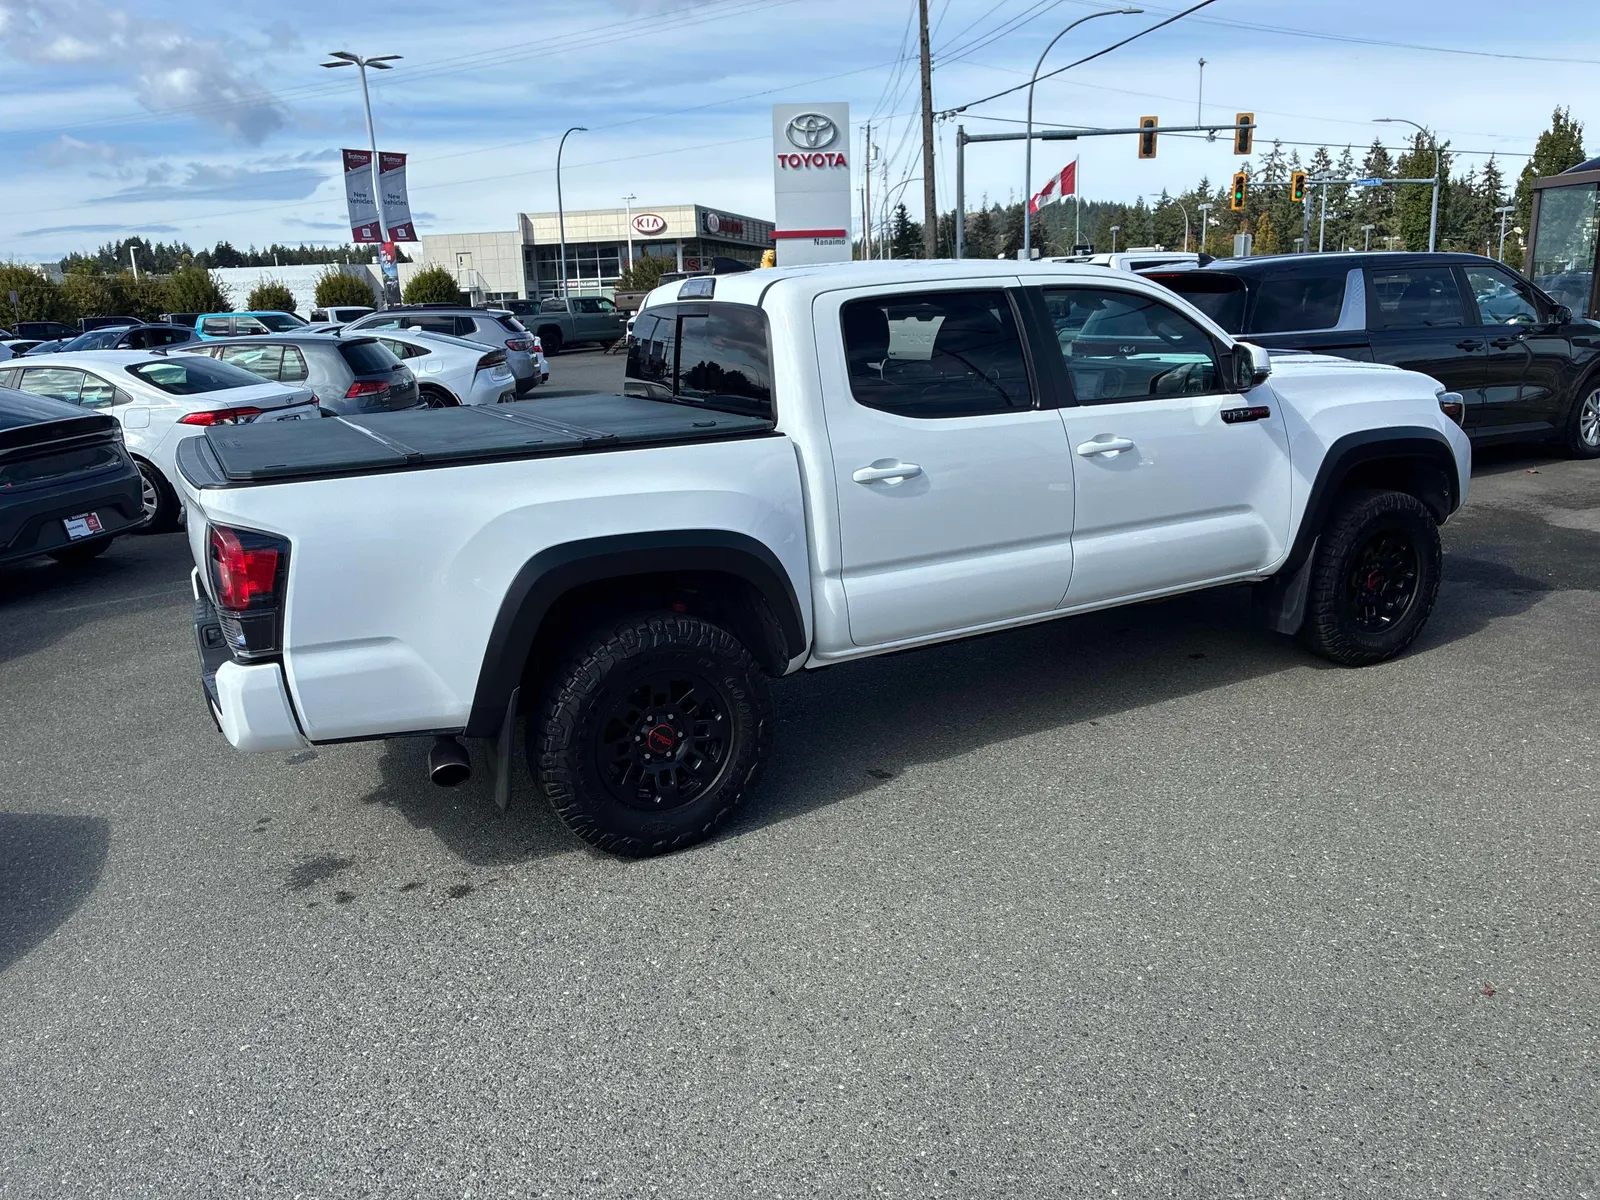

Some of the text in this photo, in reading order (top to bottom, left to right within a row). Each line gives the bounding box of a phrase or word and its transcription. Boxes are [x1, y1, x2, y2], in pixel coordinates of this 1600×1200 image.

[778, 153, 846, 168] TOYOTA
[349, 197, 373, 205] Vehicles
[637, 218, 659, 228] KIA
[813, 238, 846, 246] Nanaimo
[653, 732, 672, 746] TRD
